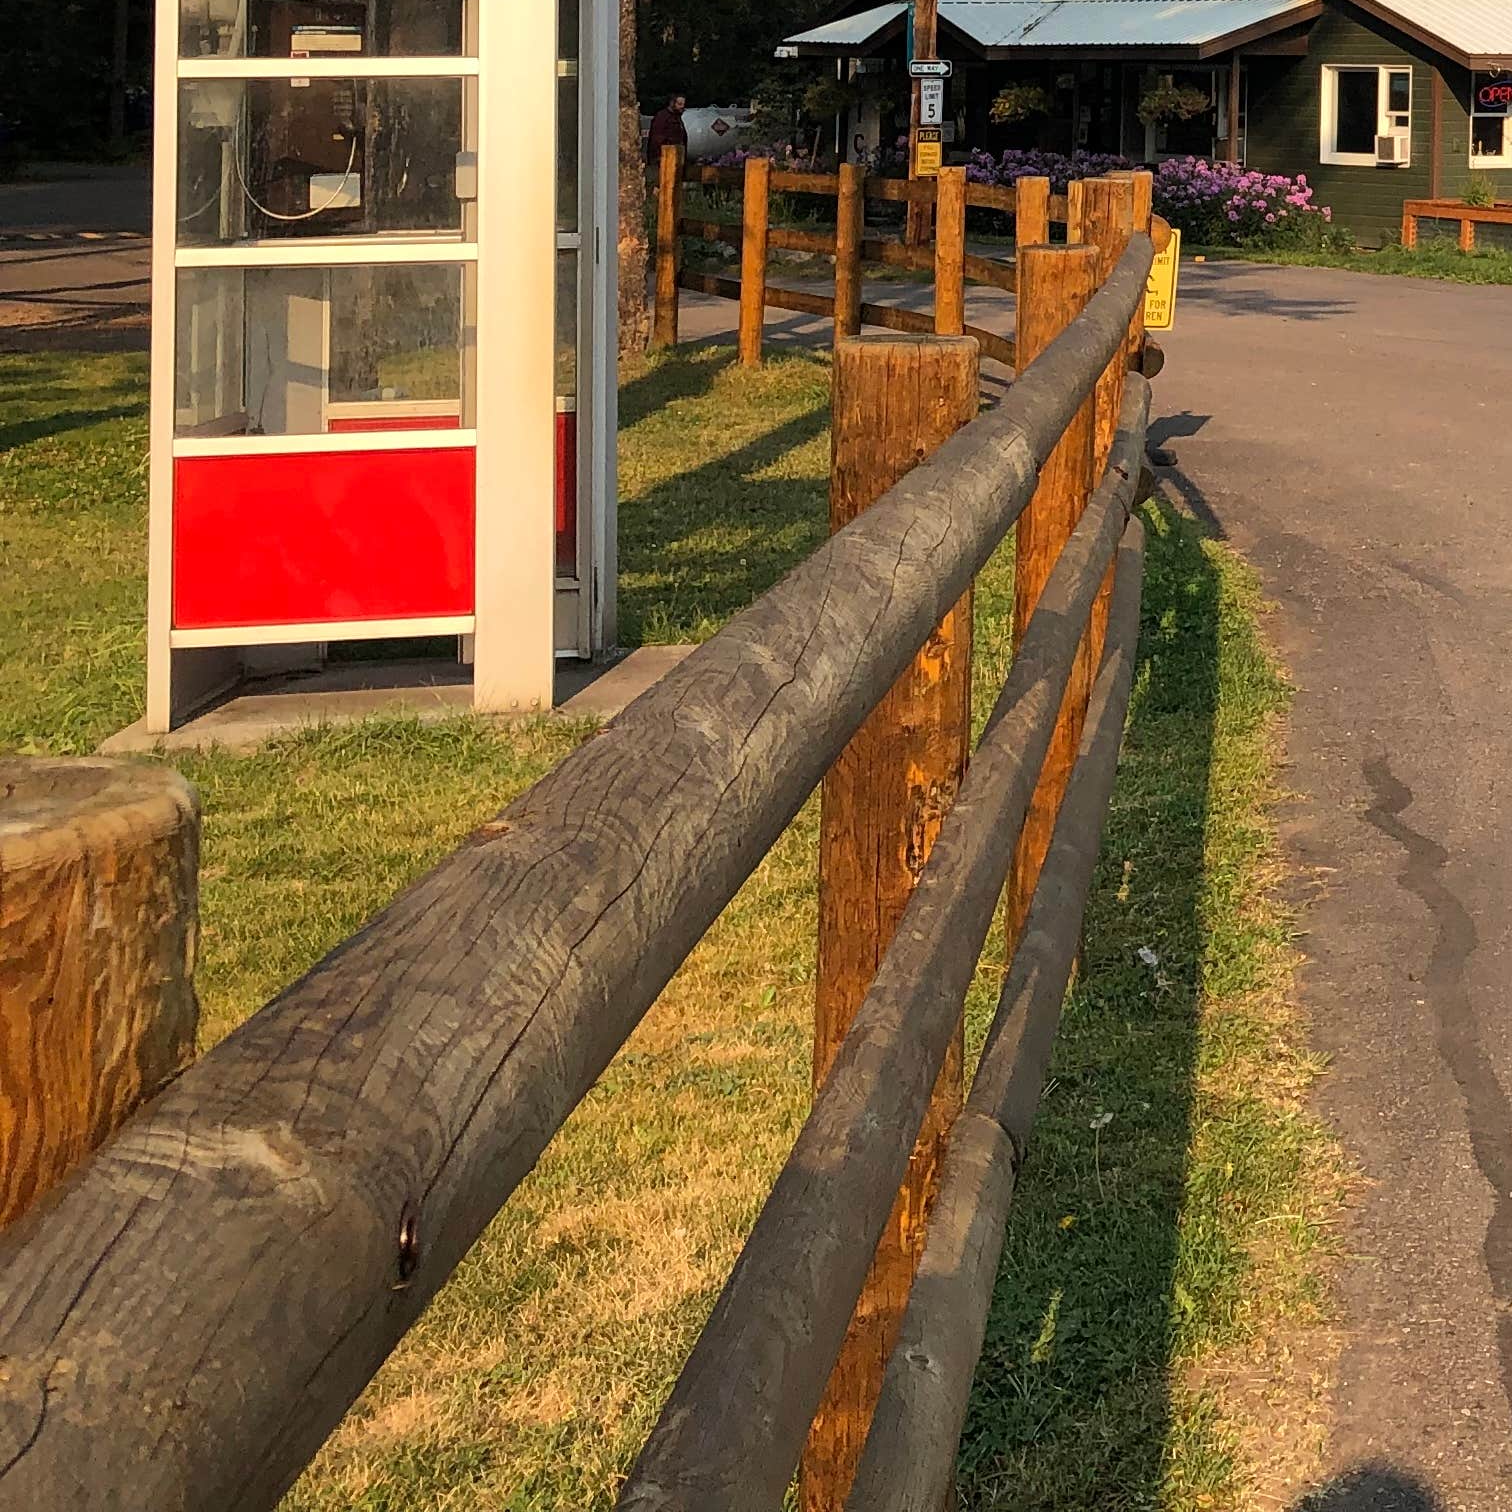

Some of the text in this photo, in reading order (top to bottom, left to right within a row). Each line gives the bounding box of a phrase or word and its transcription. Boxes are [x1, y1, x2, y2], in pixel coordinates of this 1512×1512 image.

[928, 103, 936, 118] 5
[919, 131, 940, 141] PLEASE
[1154, 256, 1170, 265] IMIT
[1149, 299, 1166, 310] FOR
